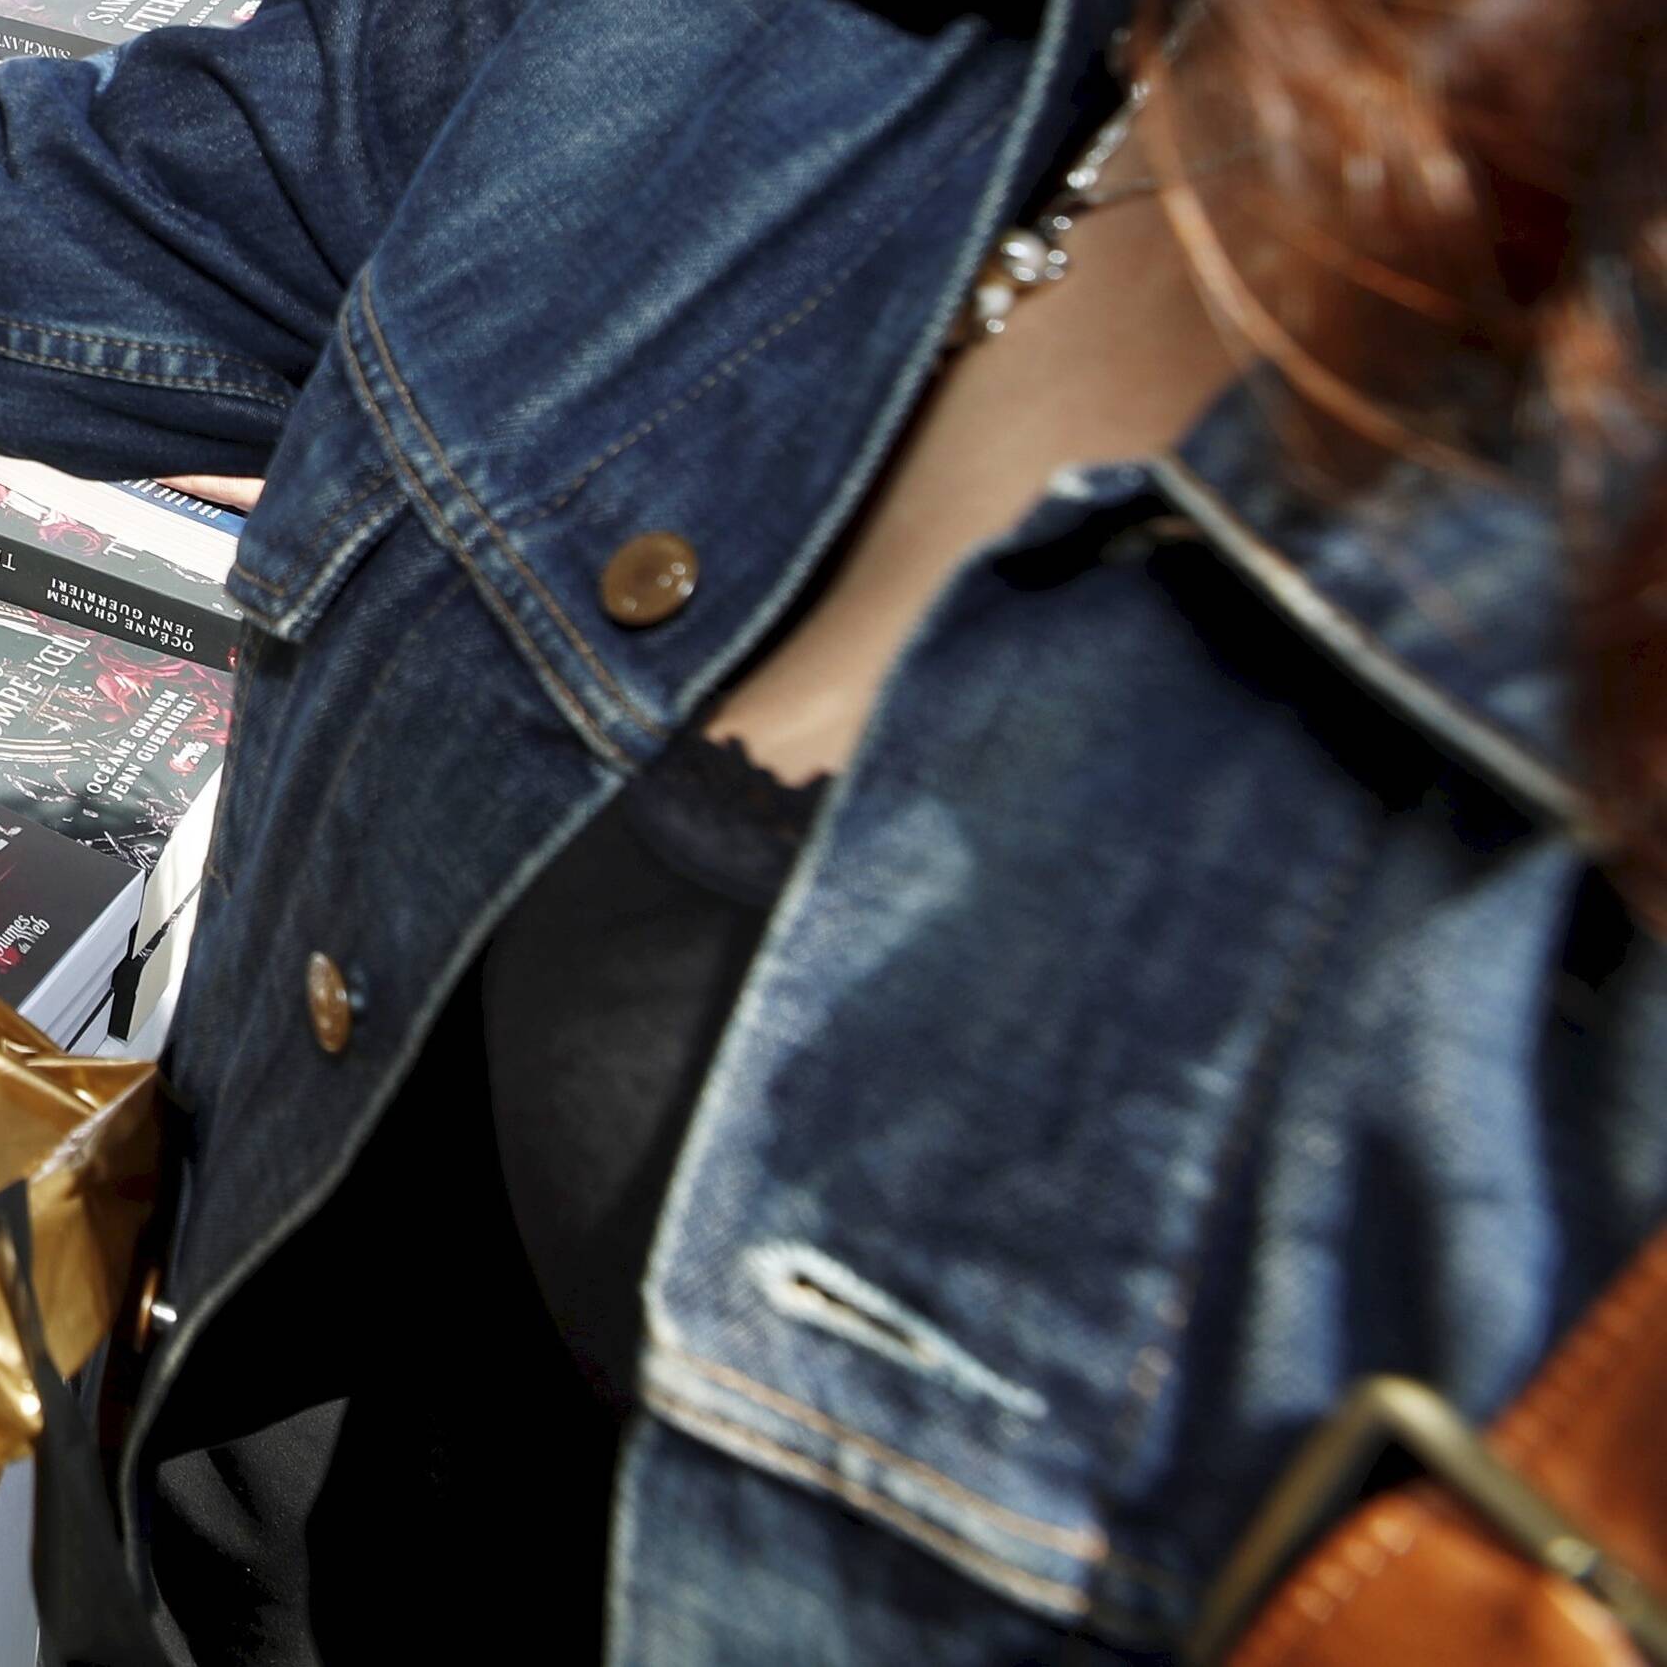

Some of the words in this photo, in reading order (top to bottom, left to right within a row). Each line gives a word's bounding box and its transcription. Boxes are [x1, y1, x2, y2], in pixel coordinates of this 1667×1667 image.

[45, 588, 119, 623] GHANEM
[49, 577, 144, 621] GUERRIERI
[124, 617, 195, 654] OCÉANE
[149, 613, 194, 640] JENN
[86, 738, 137, 795] OCÉANE
[129, 688, 180, 738] GHANEM
[107, 762, 144, 802] JENN
[136, 696, 198, 762] GUERRIERI
